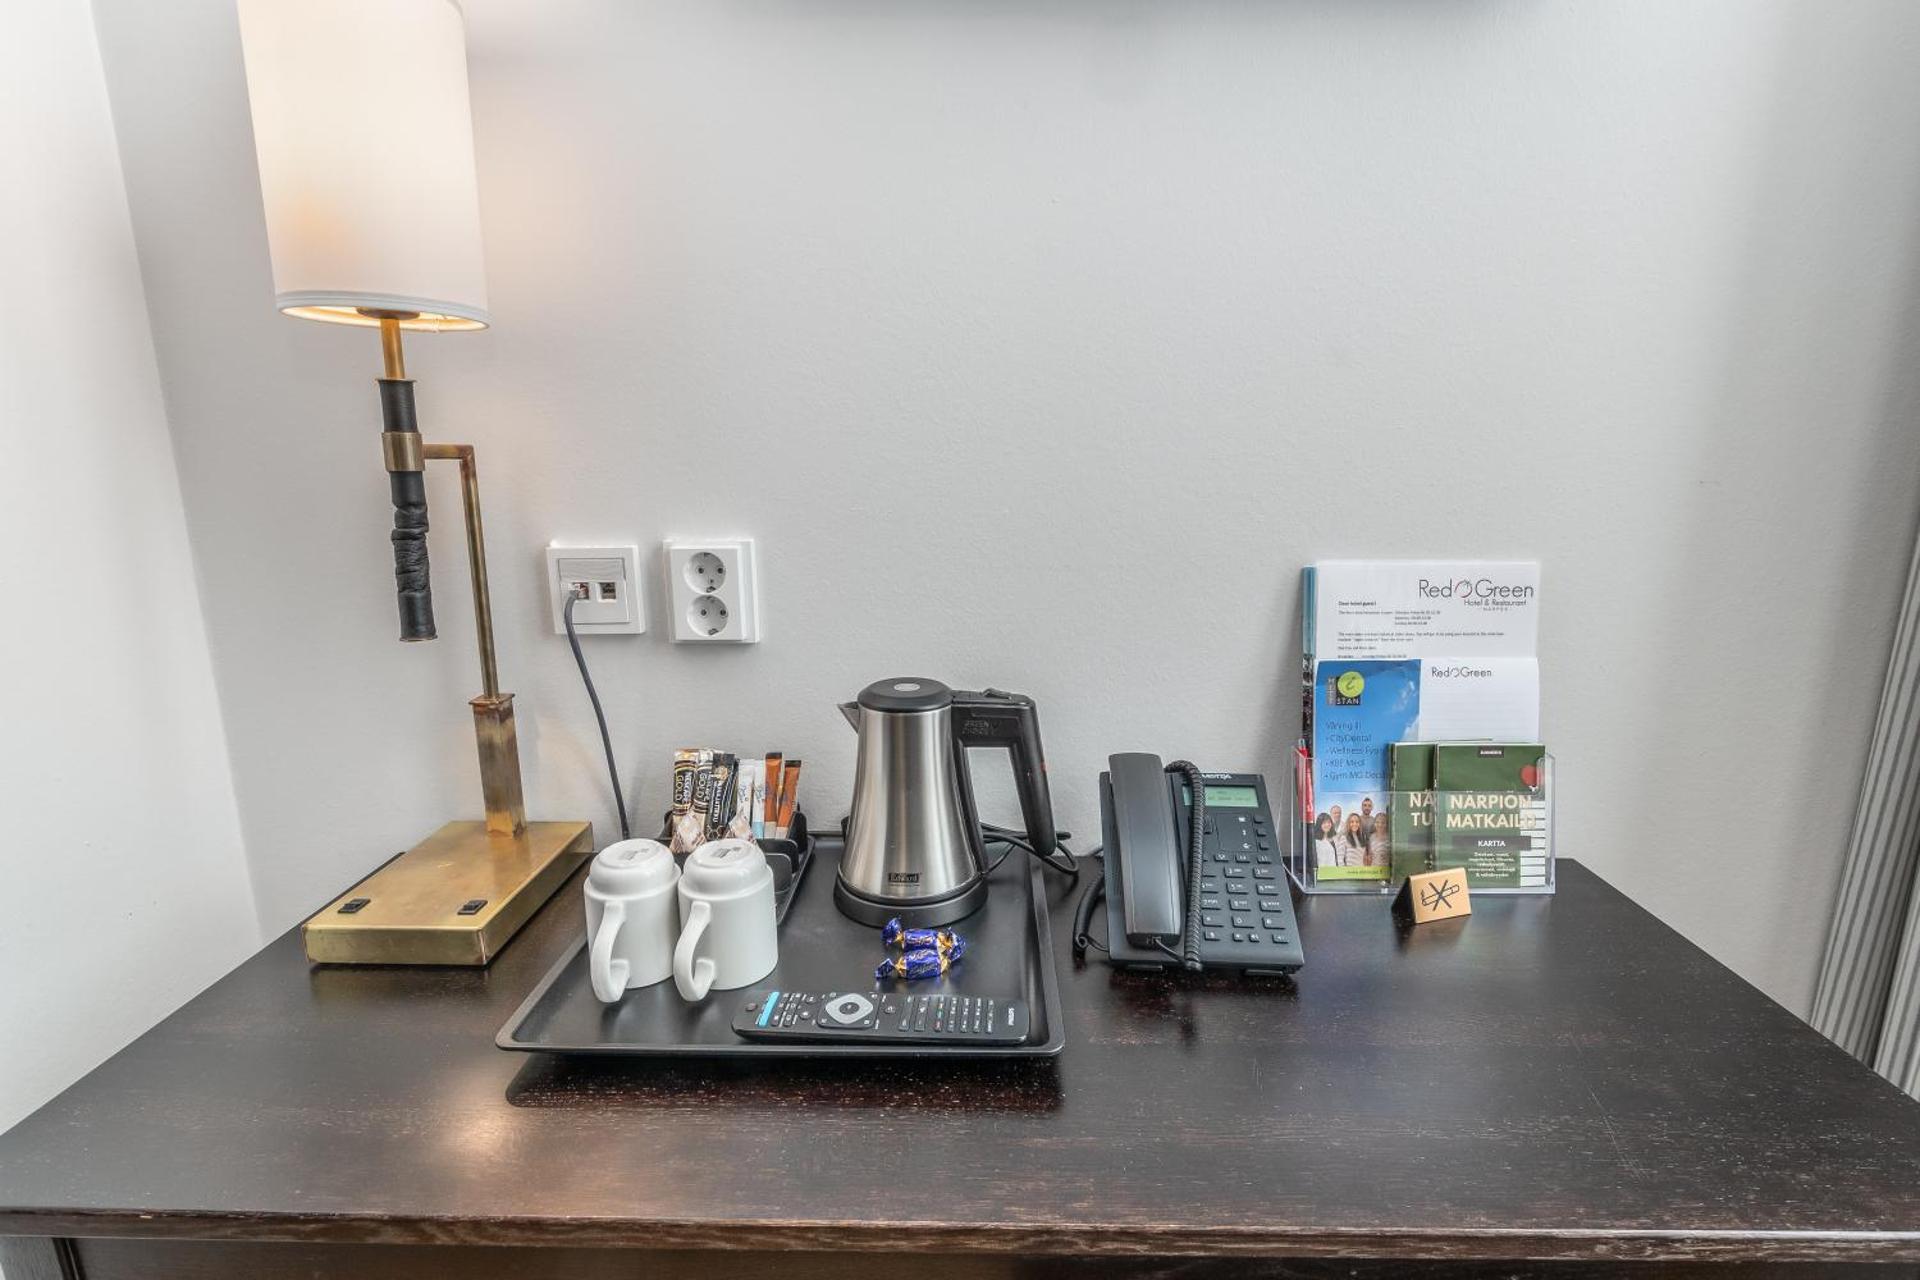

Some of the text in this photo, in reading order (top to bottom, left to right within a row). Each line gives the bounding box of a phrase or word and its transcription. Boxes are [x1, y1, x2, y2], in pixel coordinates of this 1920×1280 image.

[1419, 578, 1534, 598] Red Green
[1431, 666, 1492, 678] Red Green
[1477, 839, 1506, 847] KARTTA
